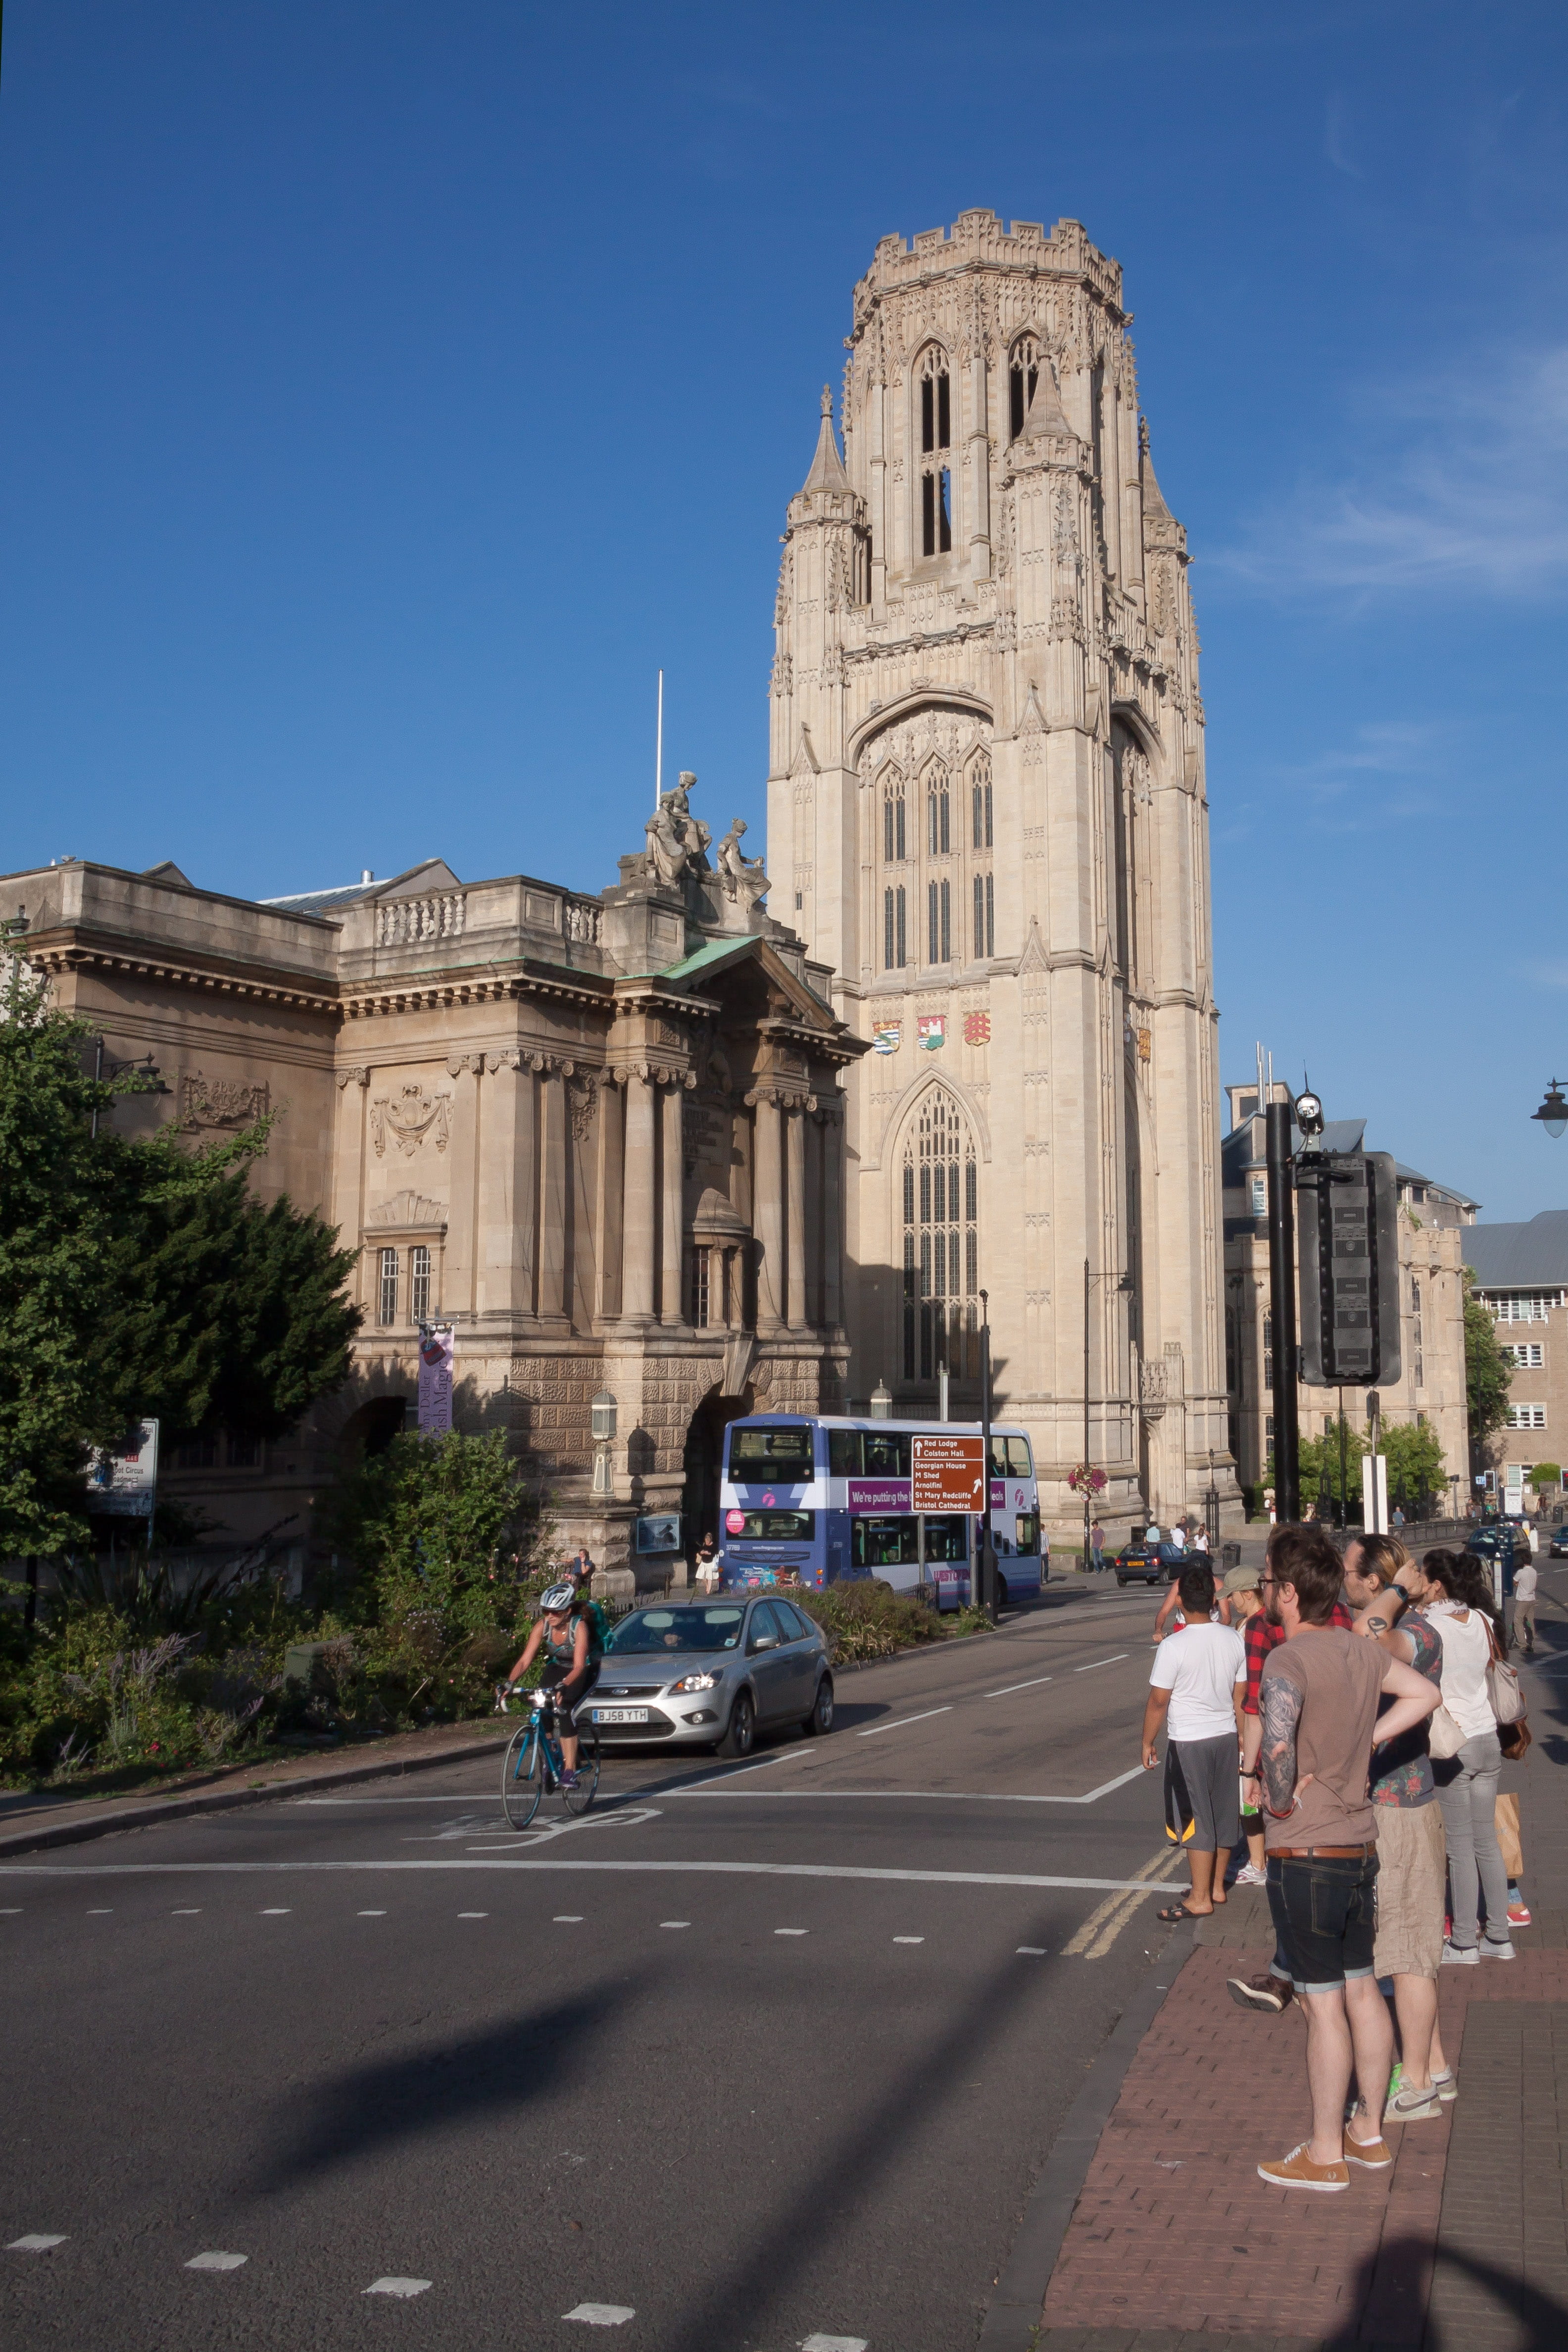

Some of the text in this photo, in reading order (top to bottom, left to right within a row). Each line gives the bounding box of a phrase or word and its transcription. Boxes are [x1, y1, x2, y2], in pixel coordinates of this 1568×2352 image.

[434, 1361, 452, 1406] Magic
[420, 1375, 431, 1409] Deller
[852, 1491, 872, 1503] We're
[873, 1491, 896, 1505] putting
[897, 1491, 908, 1503] the
[925, 1491, 940, 1500] Mary
[991, 1490, 1004, 1501] eals
[599, 1710, 646, 1721] BJ58 YTH
